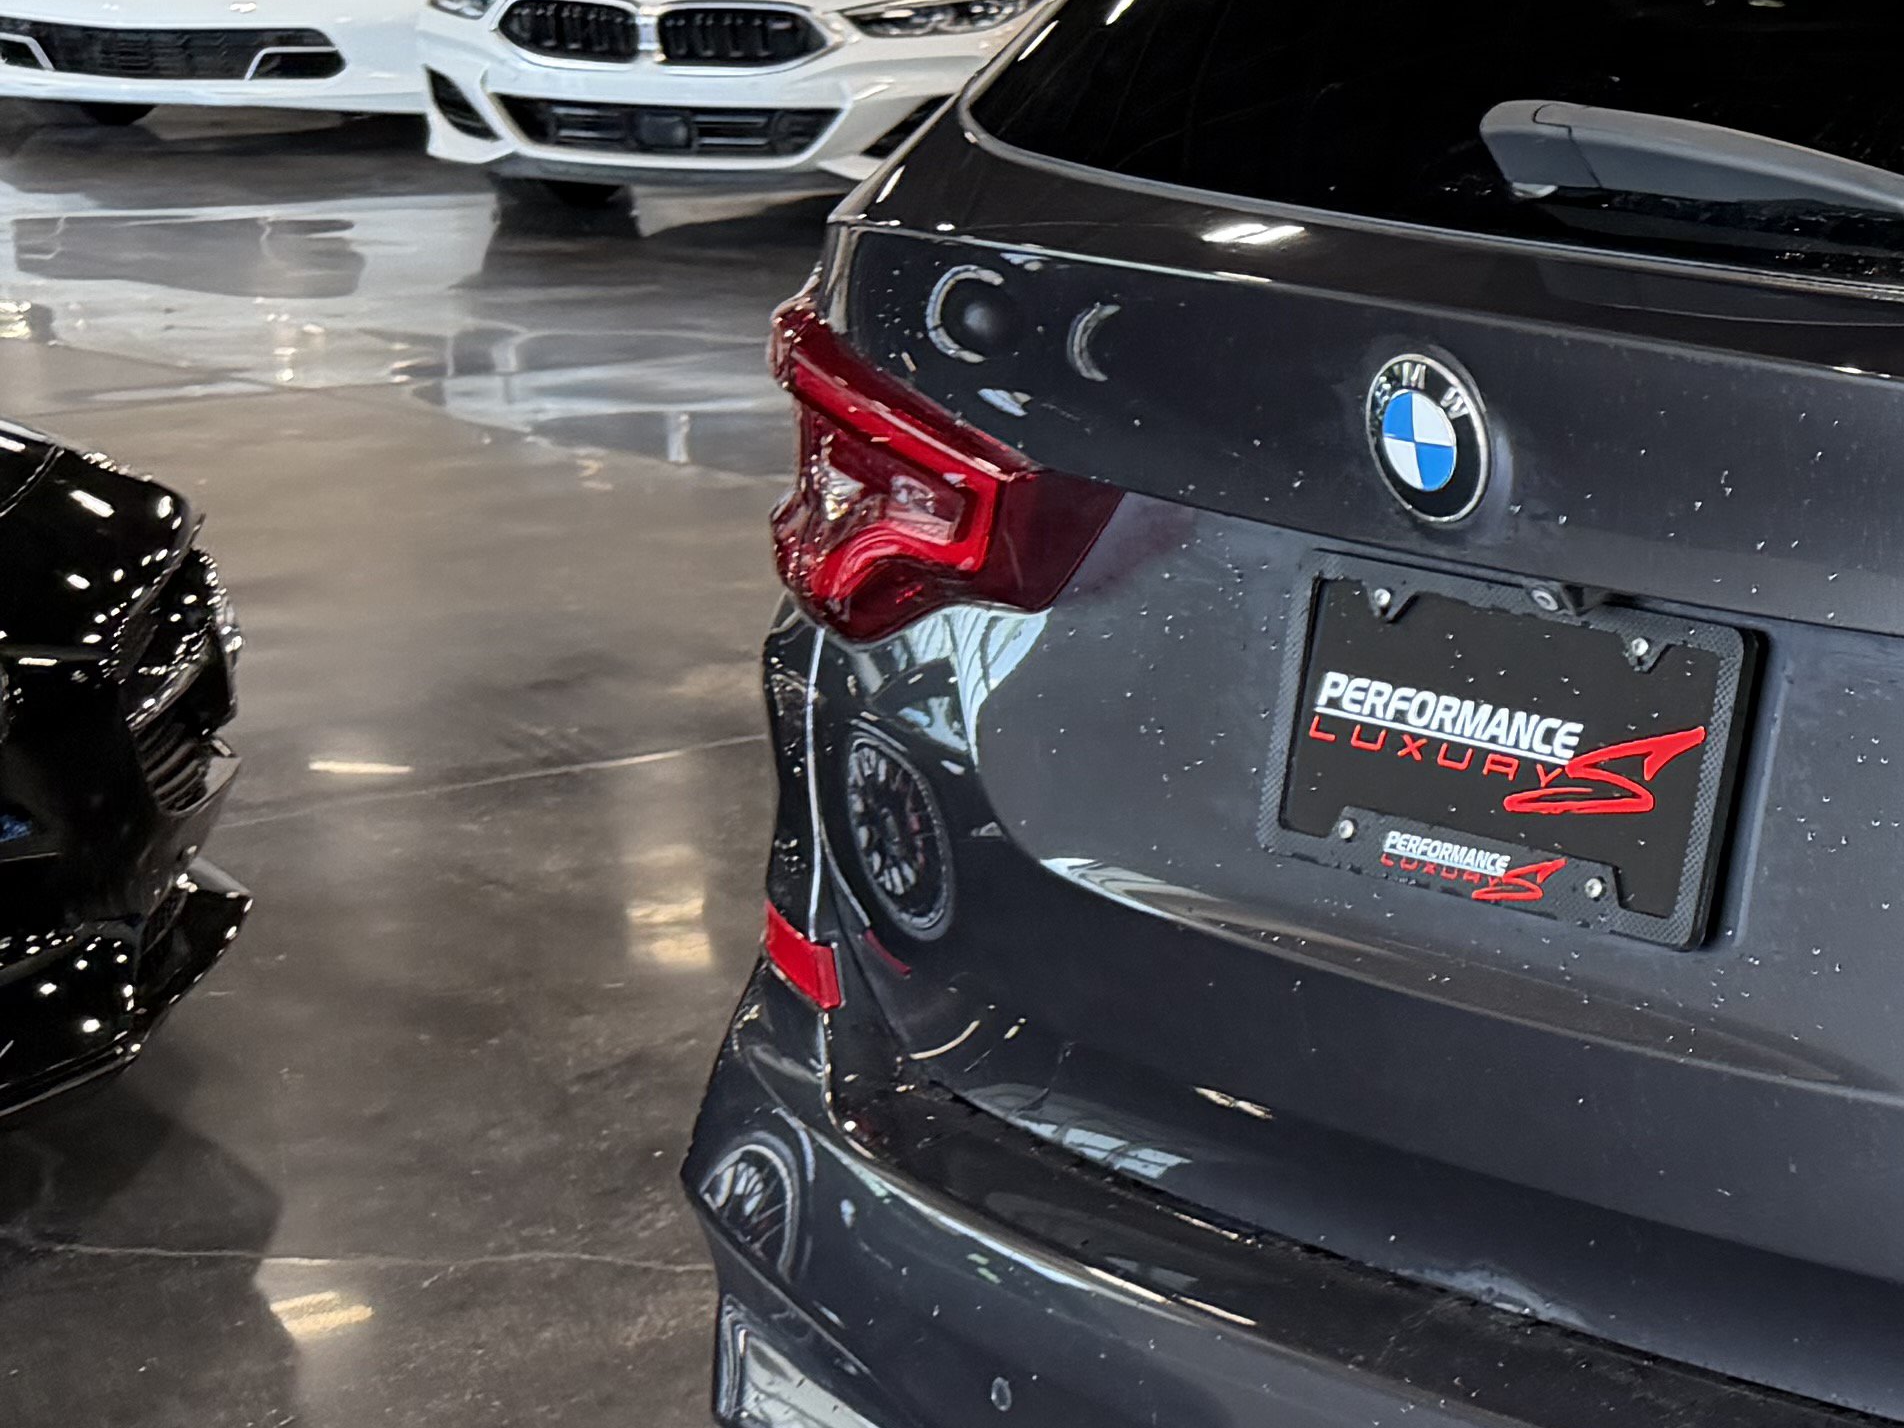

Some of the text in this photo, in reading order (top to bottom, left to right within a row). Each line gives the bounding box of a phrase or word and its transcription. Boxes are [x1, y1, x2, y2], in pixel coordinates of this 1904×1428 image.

[1308, 715, 1564, 789] LUXURY
[1316, 671, 1584, 759] PERFORMANCE
[1385, 830, 1512, 874] PERFORMANCE
